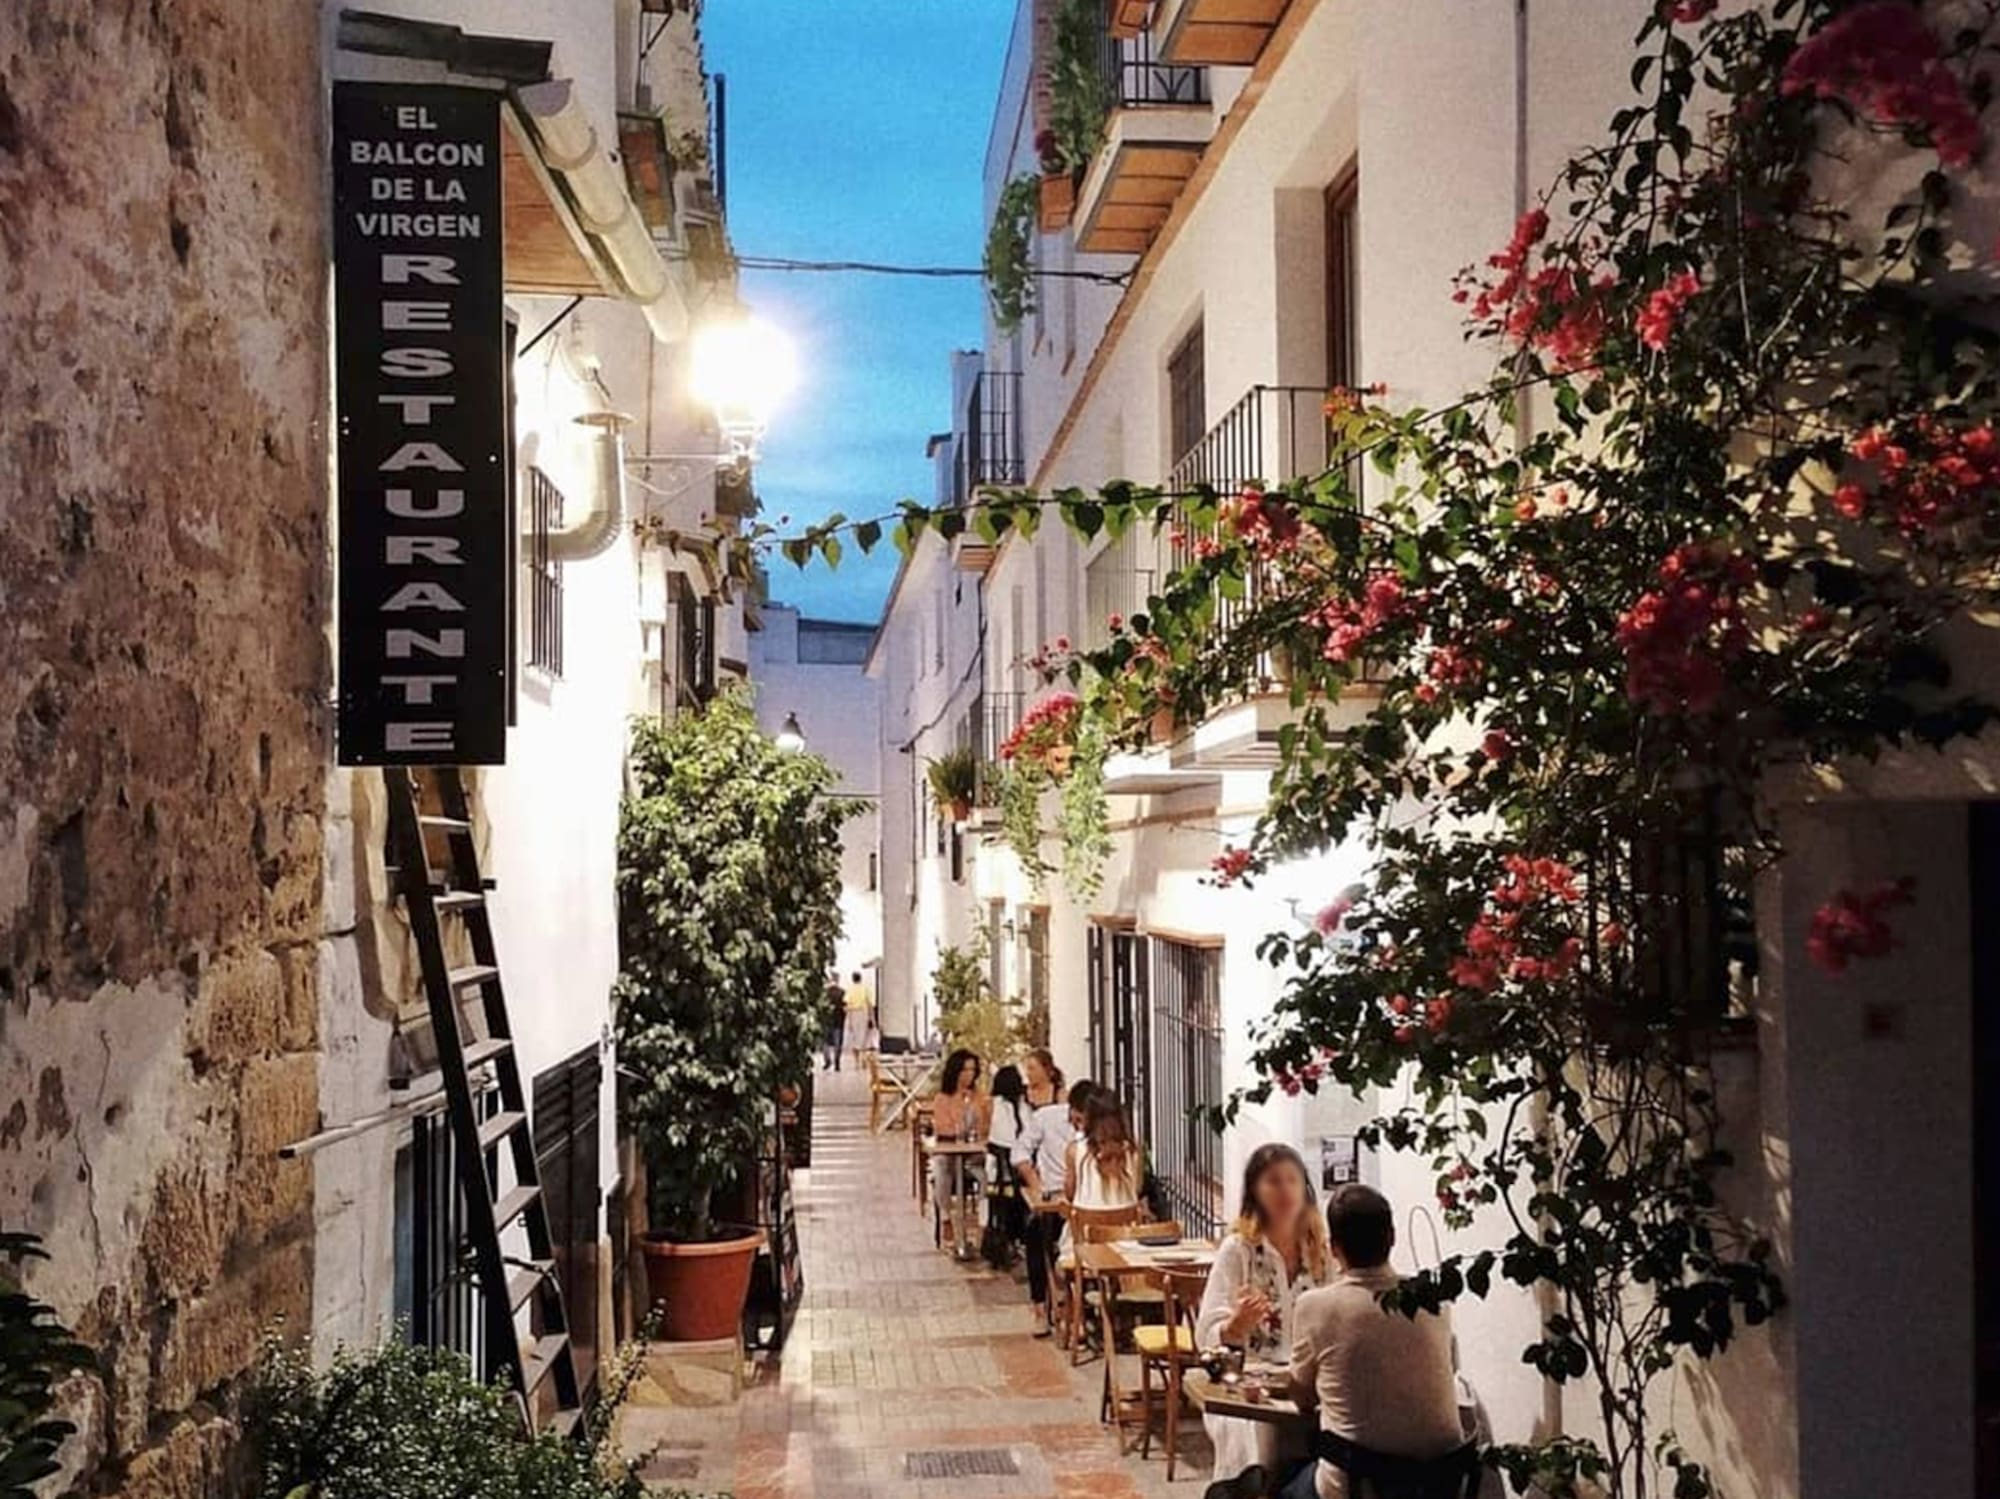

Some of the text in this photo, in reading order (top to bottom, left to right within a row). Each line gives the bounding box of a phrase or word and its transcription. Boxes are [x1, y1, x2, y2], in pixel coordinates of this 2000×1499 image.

[397, 106, 437, 129] EL
[350, 141, 485, 166] BALCON
[371, 178, 467, 202] DE LA
[356, 213, 481, 238] VIRGEN
[377, 254, 465, 751] RESTAURANTE
